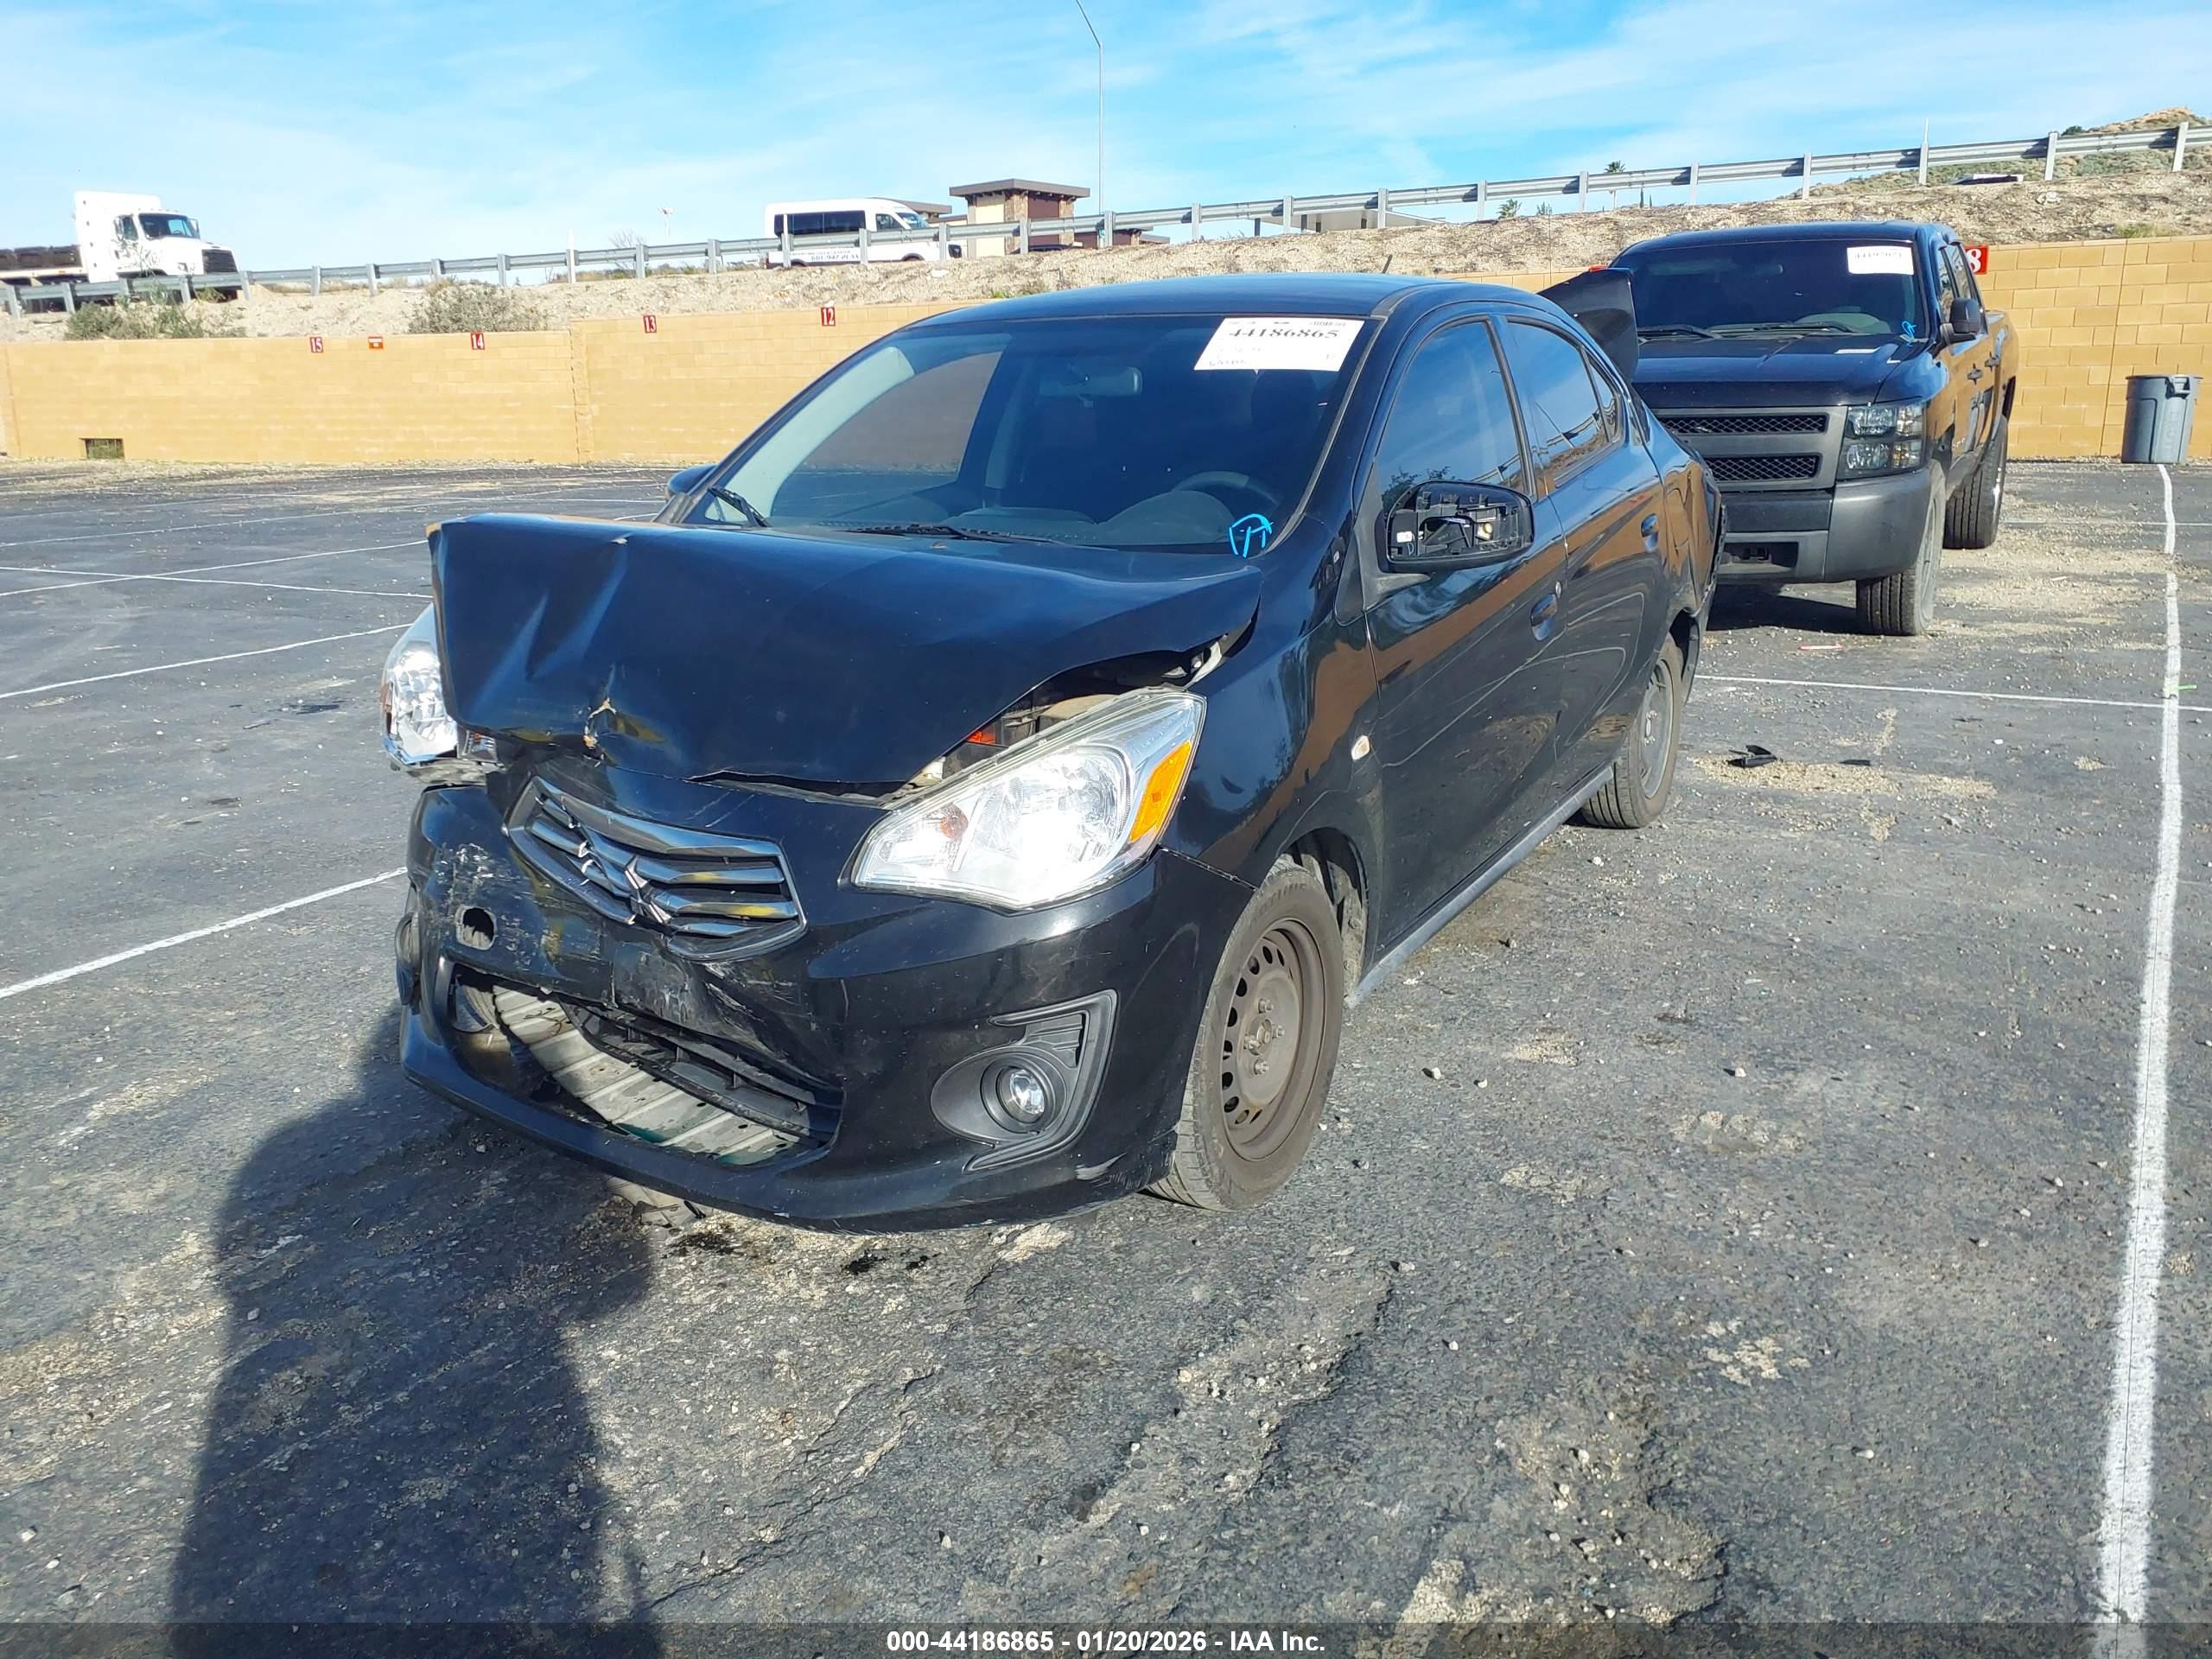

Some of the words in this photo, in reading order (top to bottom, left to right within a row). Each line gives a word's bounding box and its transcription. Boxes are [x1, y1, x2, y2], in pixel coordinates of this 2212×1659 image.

[1966, 248, 1981, 272] 8
[645, 316, 656, 333] 13
[822, 308, 835, 326] 12
[1229, 327, 1339, 339] 44186865
[311, 337, 322, 353] 15
[472, 334, 484, 349] 14
